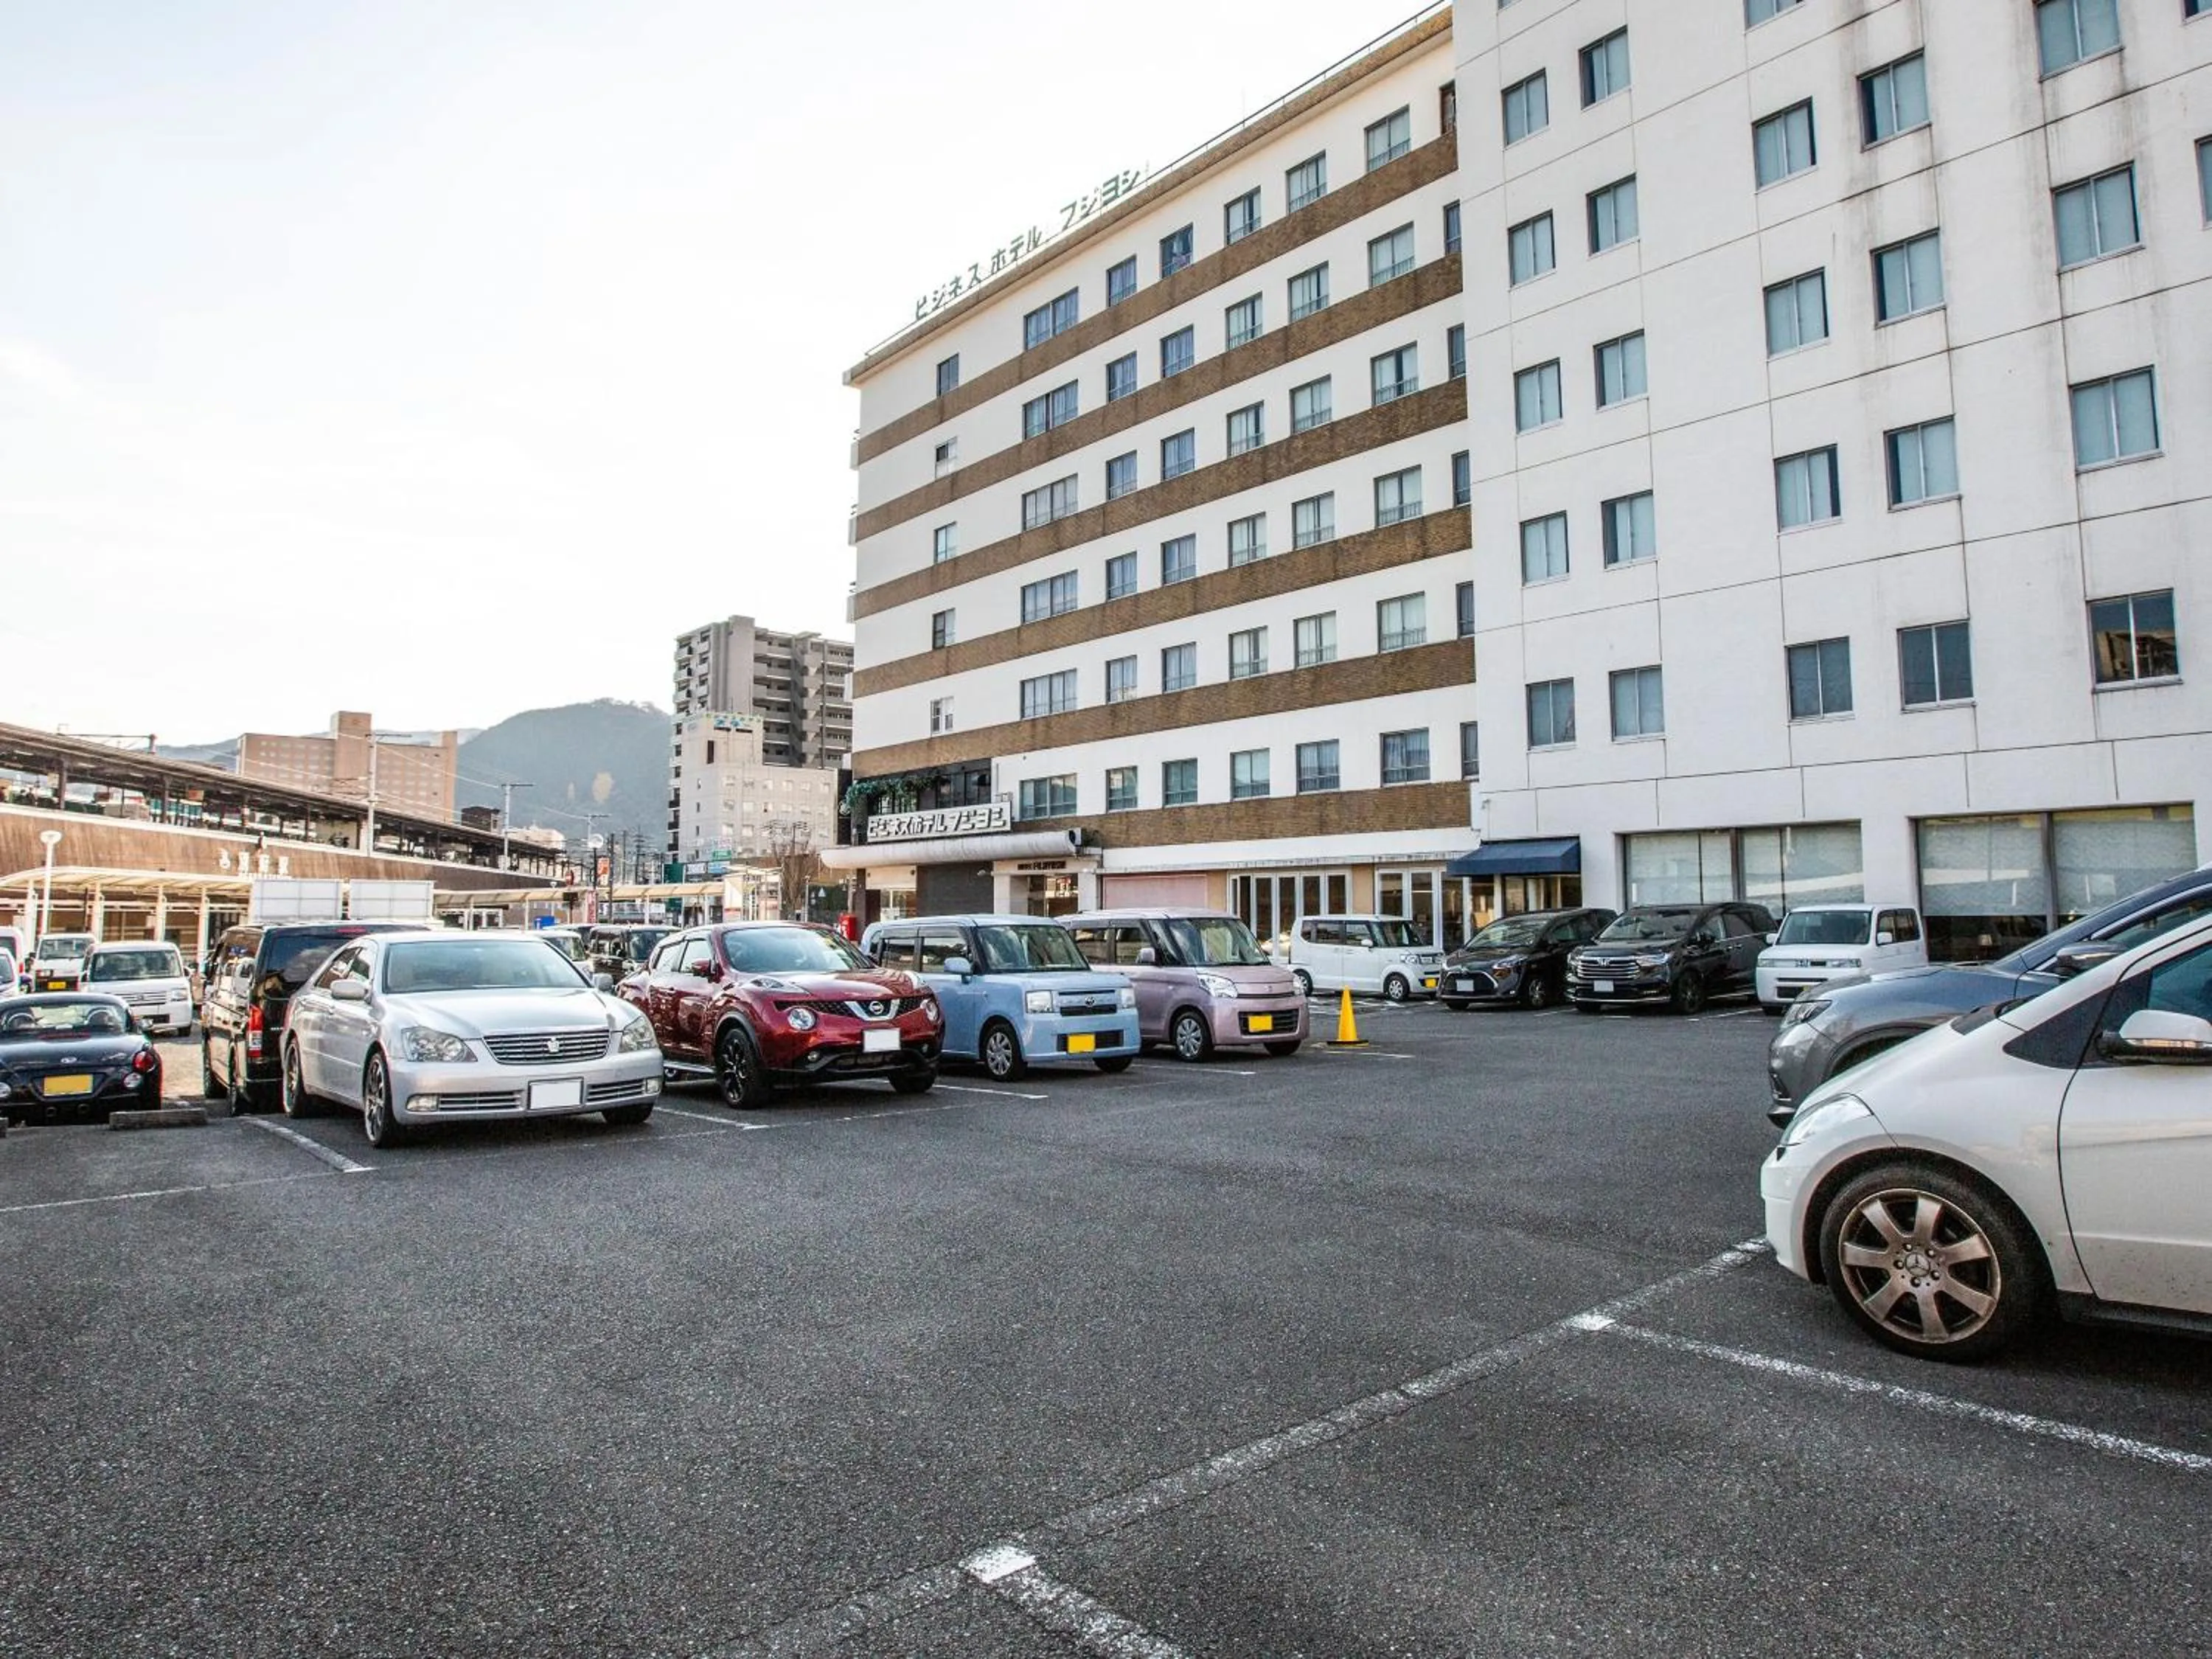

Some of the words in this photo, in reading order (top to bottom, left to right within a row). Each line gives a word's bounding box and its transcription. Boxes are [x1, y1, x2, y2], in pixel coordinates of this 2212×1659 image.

[990, 226, 1042, 274] ホテル
[1060, 170, 1140, 232] フジヨシ
